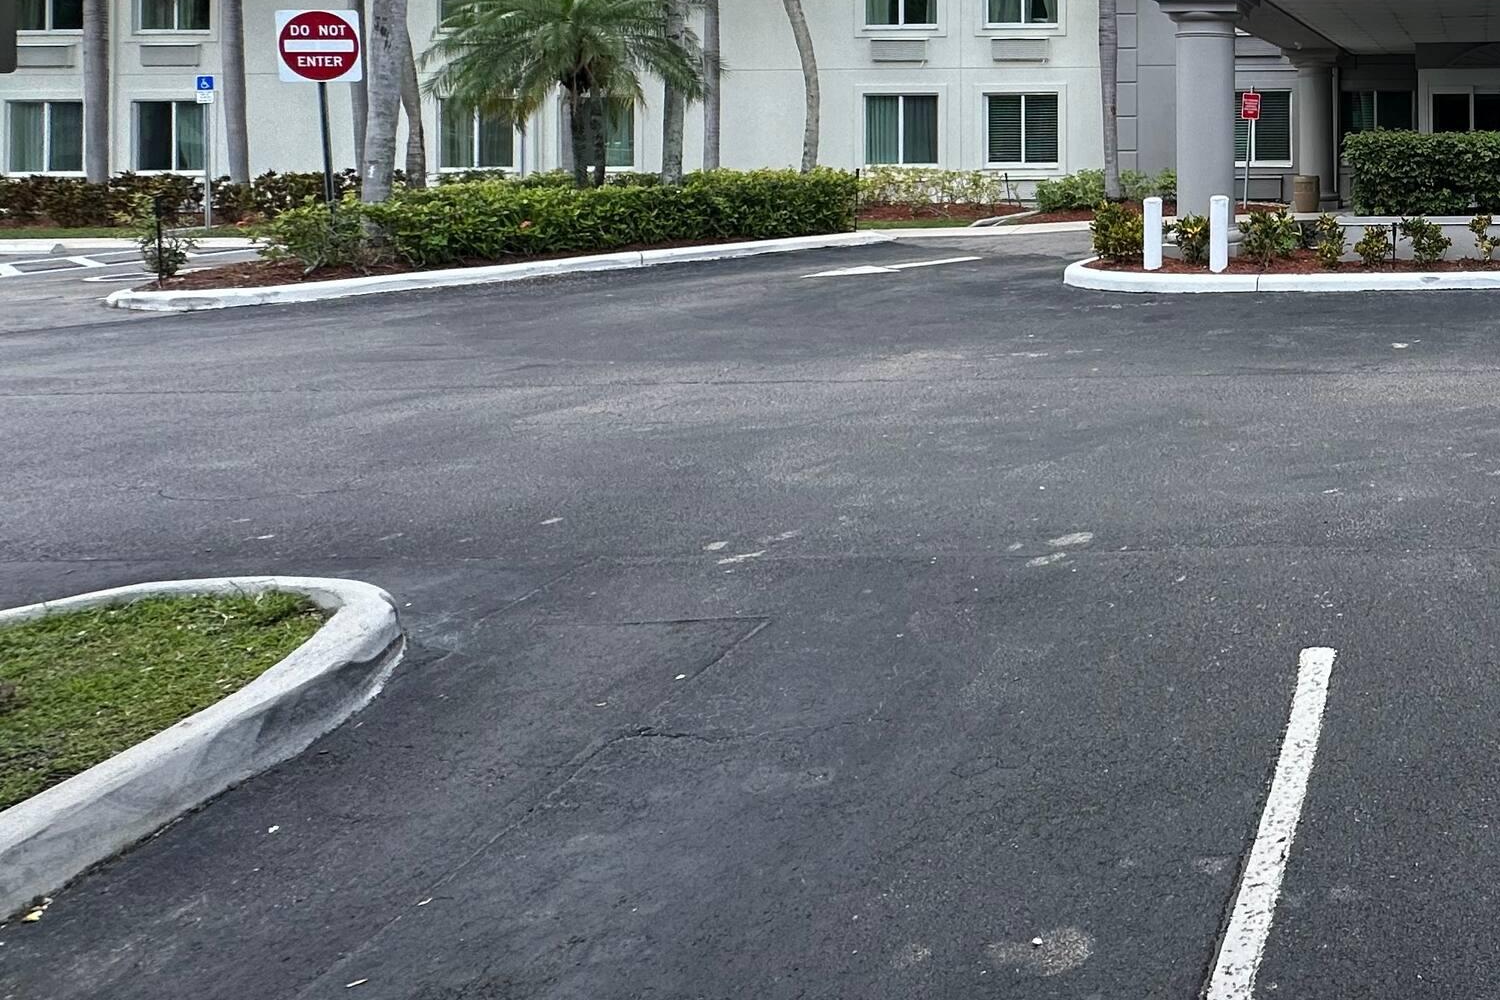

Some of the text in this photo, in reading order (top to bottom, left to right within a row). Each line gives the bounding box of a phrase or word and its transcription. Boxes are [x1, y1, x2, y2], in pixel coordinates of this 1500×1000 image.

[289, 24, 347, 37] DO NOT
[297, 55, 343, 67] ENTER
